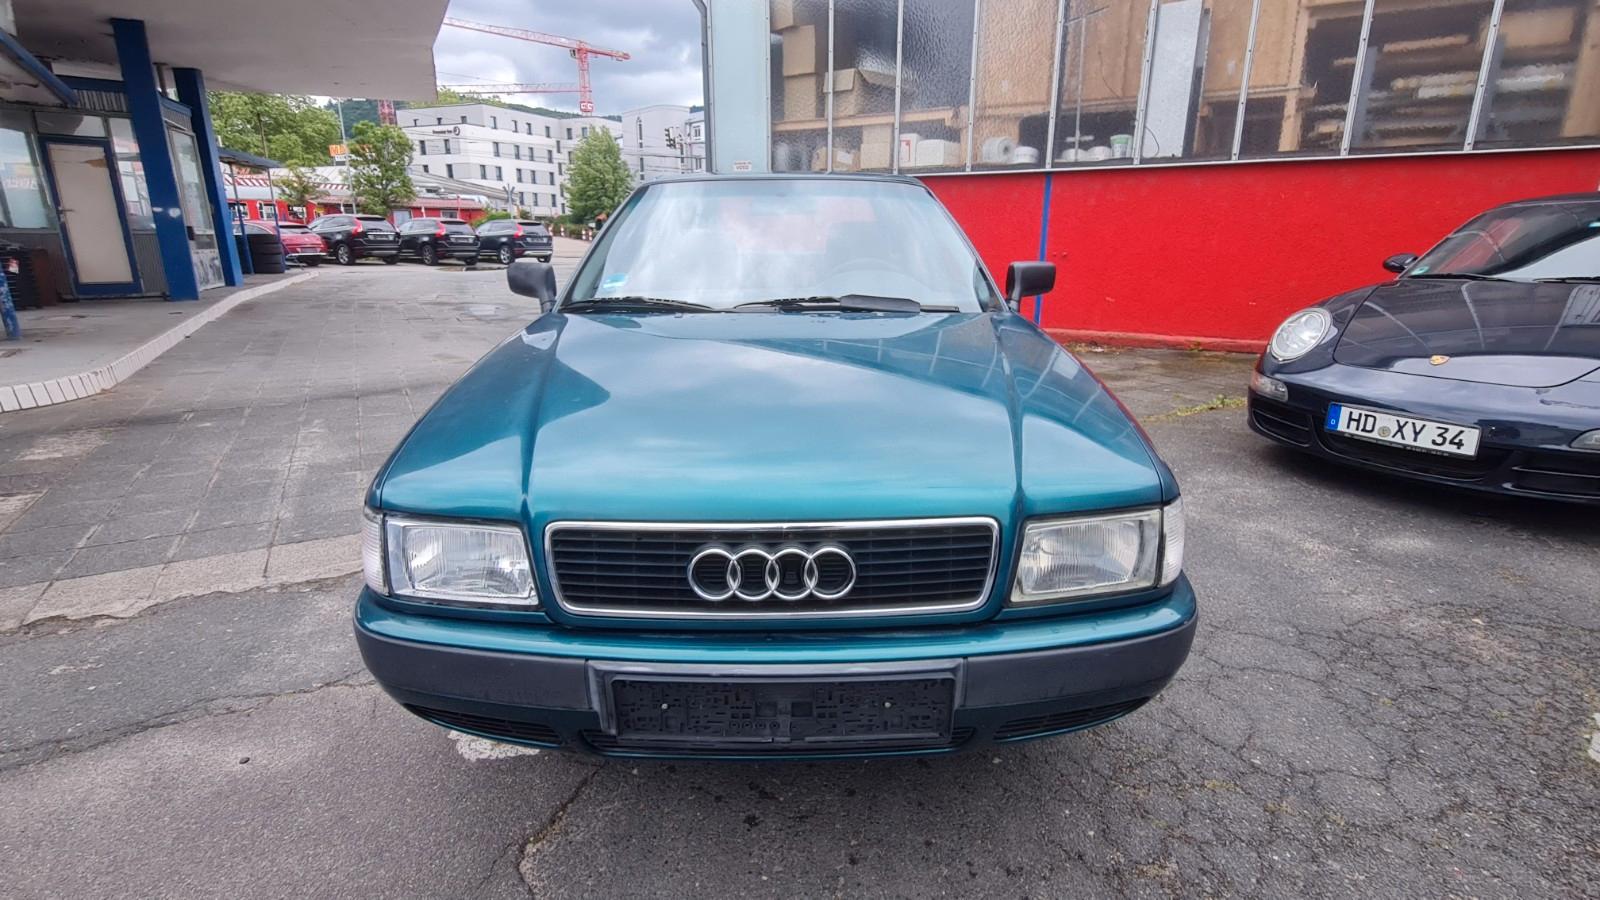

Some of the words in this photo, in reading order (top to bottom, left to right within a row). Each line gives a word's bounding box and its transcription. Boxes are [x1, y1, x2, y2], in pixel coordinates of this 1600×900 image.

[1347, 411, 1377, 433] HD
[1391, 419, 1426, 442] XY
[1431, 426, 1465, 450] 34
